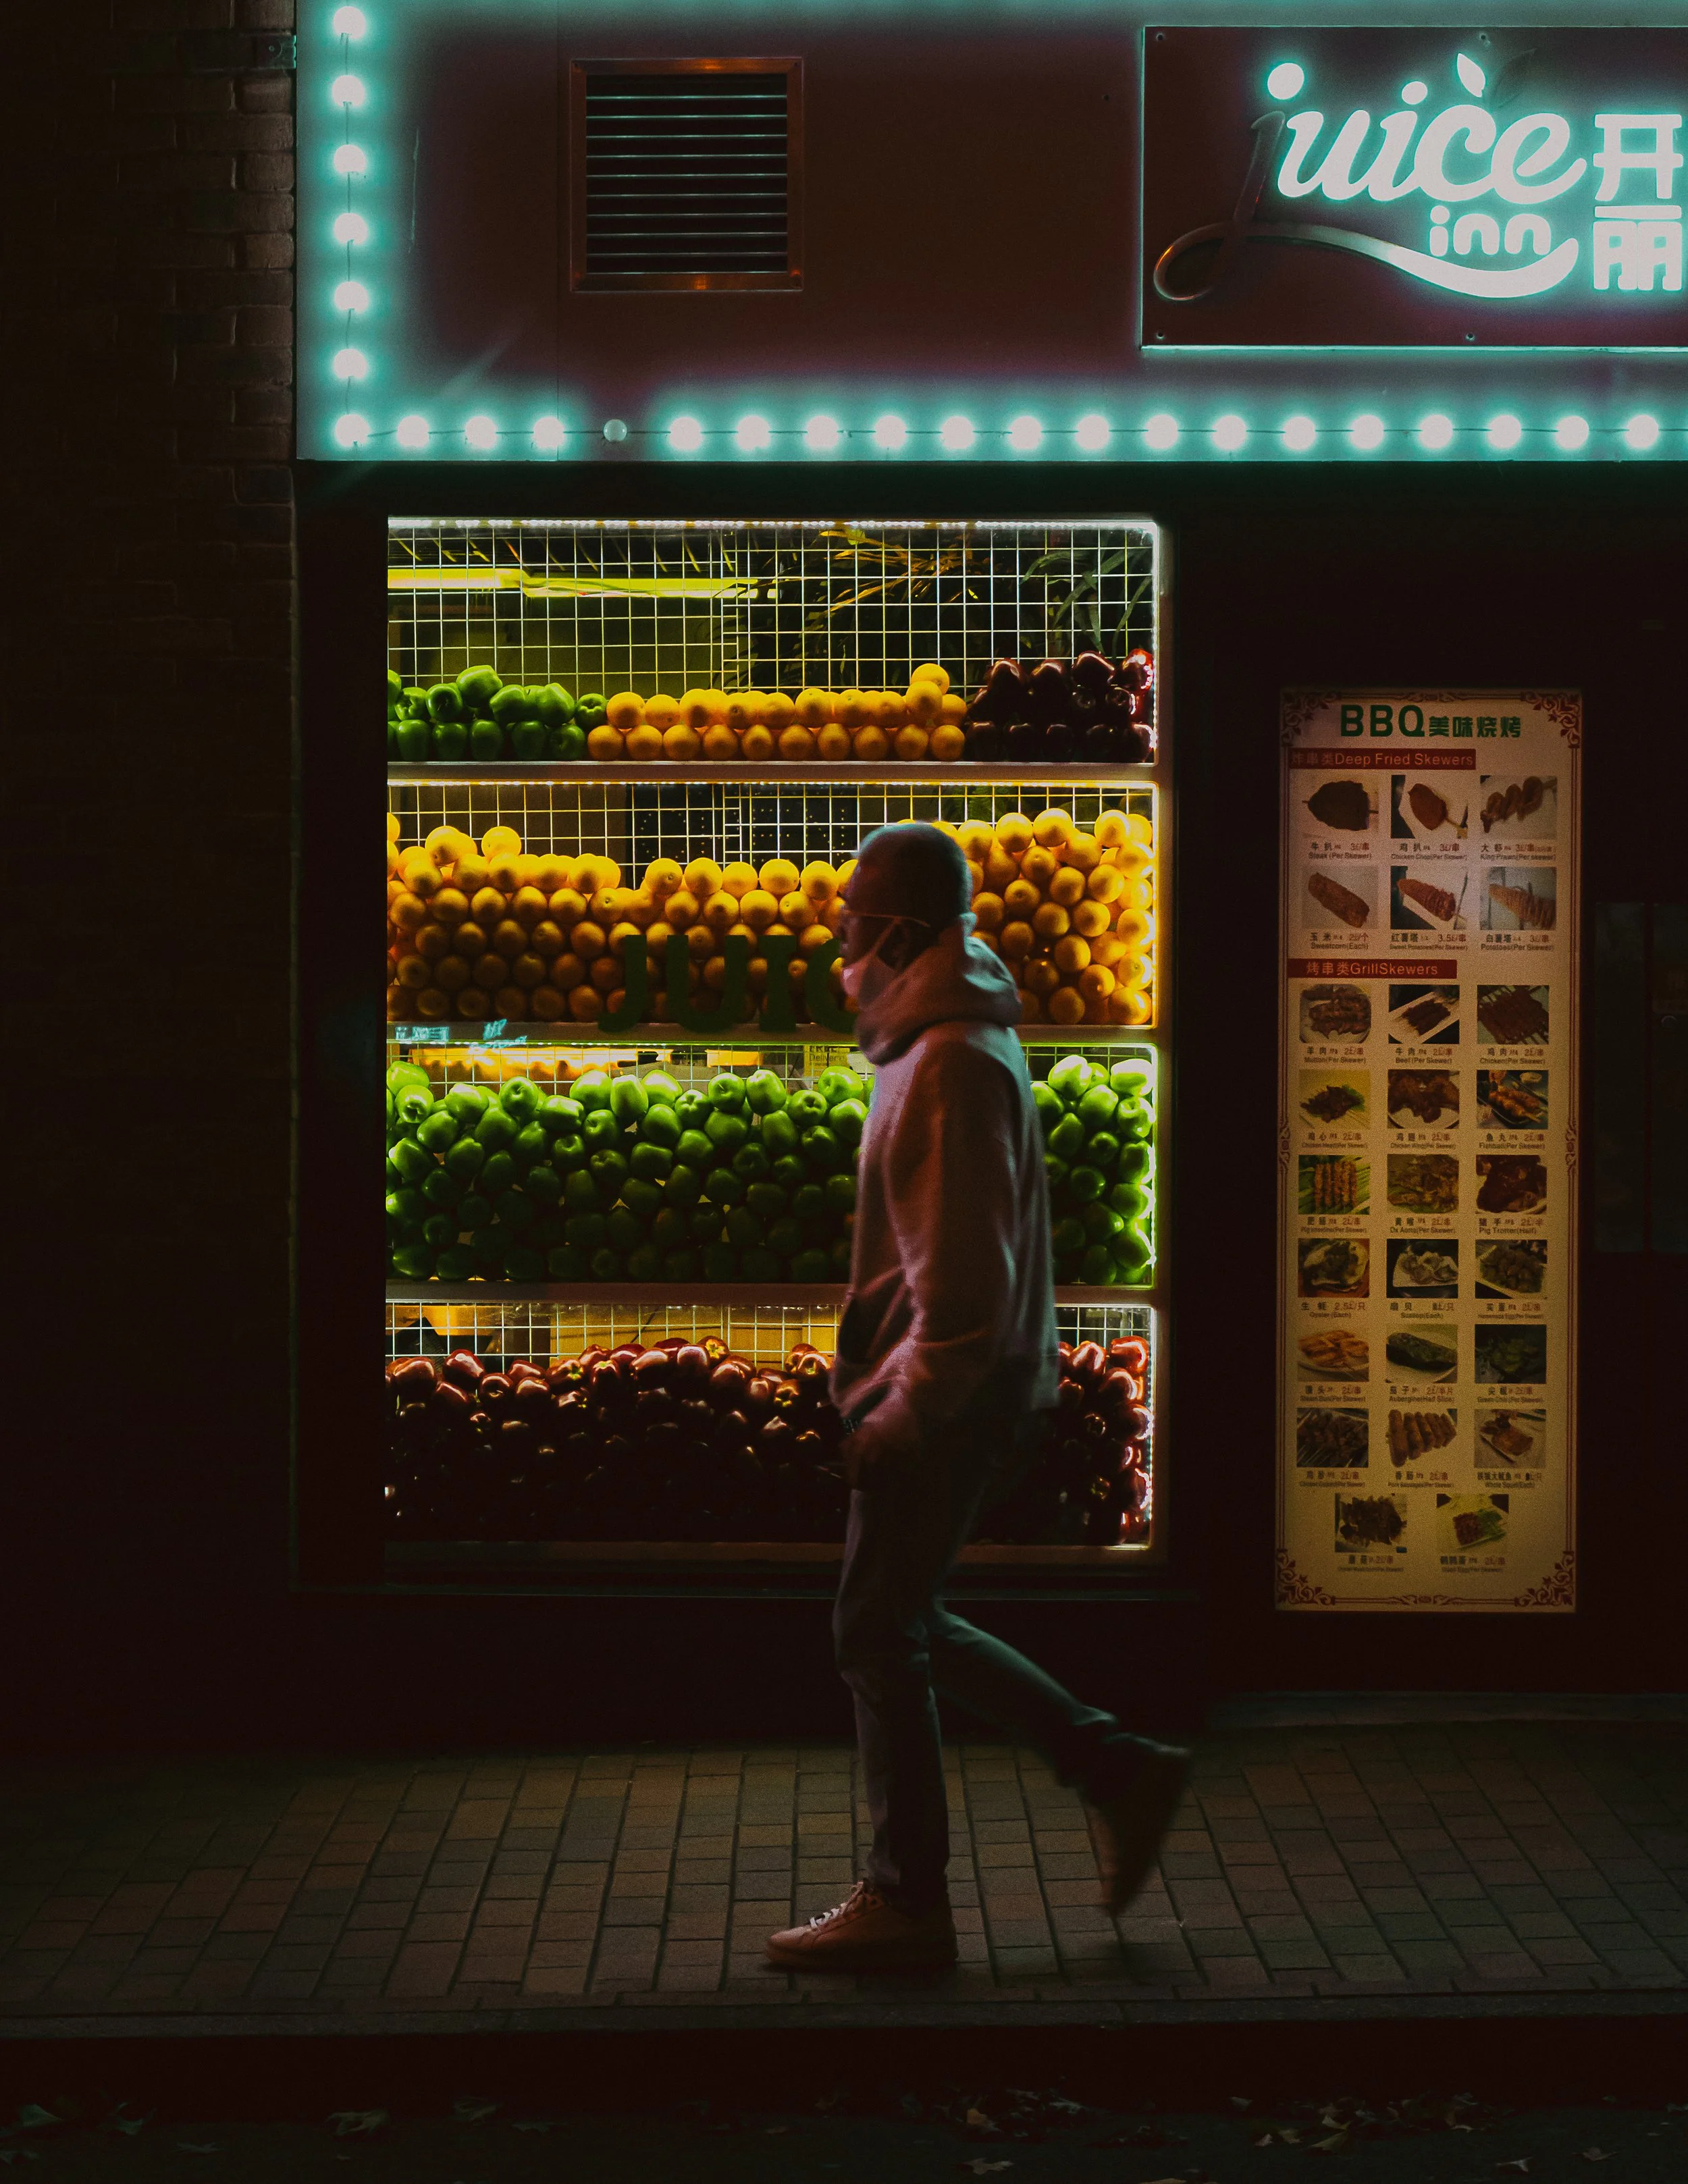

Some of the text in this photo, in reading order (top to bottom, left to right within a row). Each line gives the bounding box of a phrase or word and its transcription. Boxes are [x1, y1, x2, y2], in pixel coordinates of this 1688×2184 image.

[1430, 205, 1552, 257] inn
[1340, 704, 1521, 739] BBQ 美味烧烤
[1335, 753, 1371, 768] Deep
[1375, 753, 1410, 766] Fried
[1414, 753, 1474, 766] Skewers
[1307, 961, 1439, 976] 烤串类 GrillSkewers
